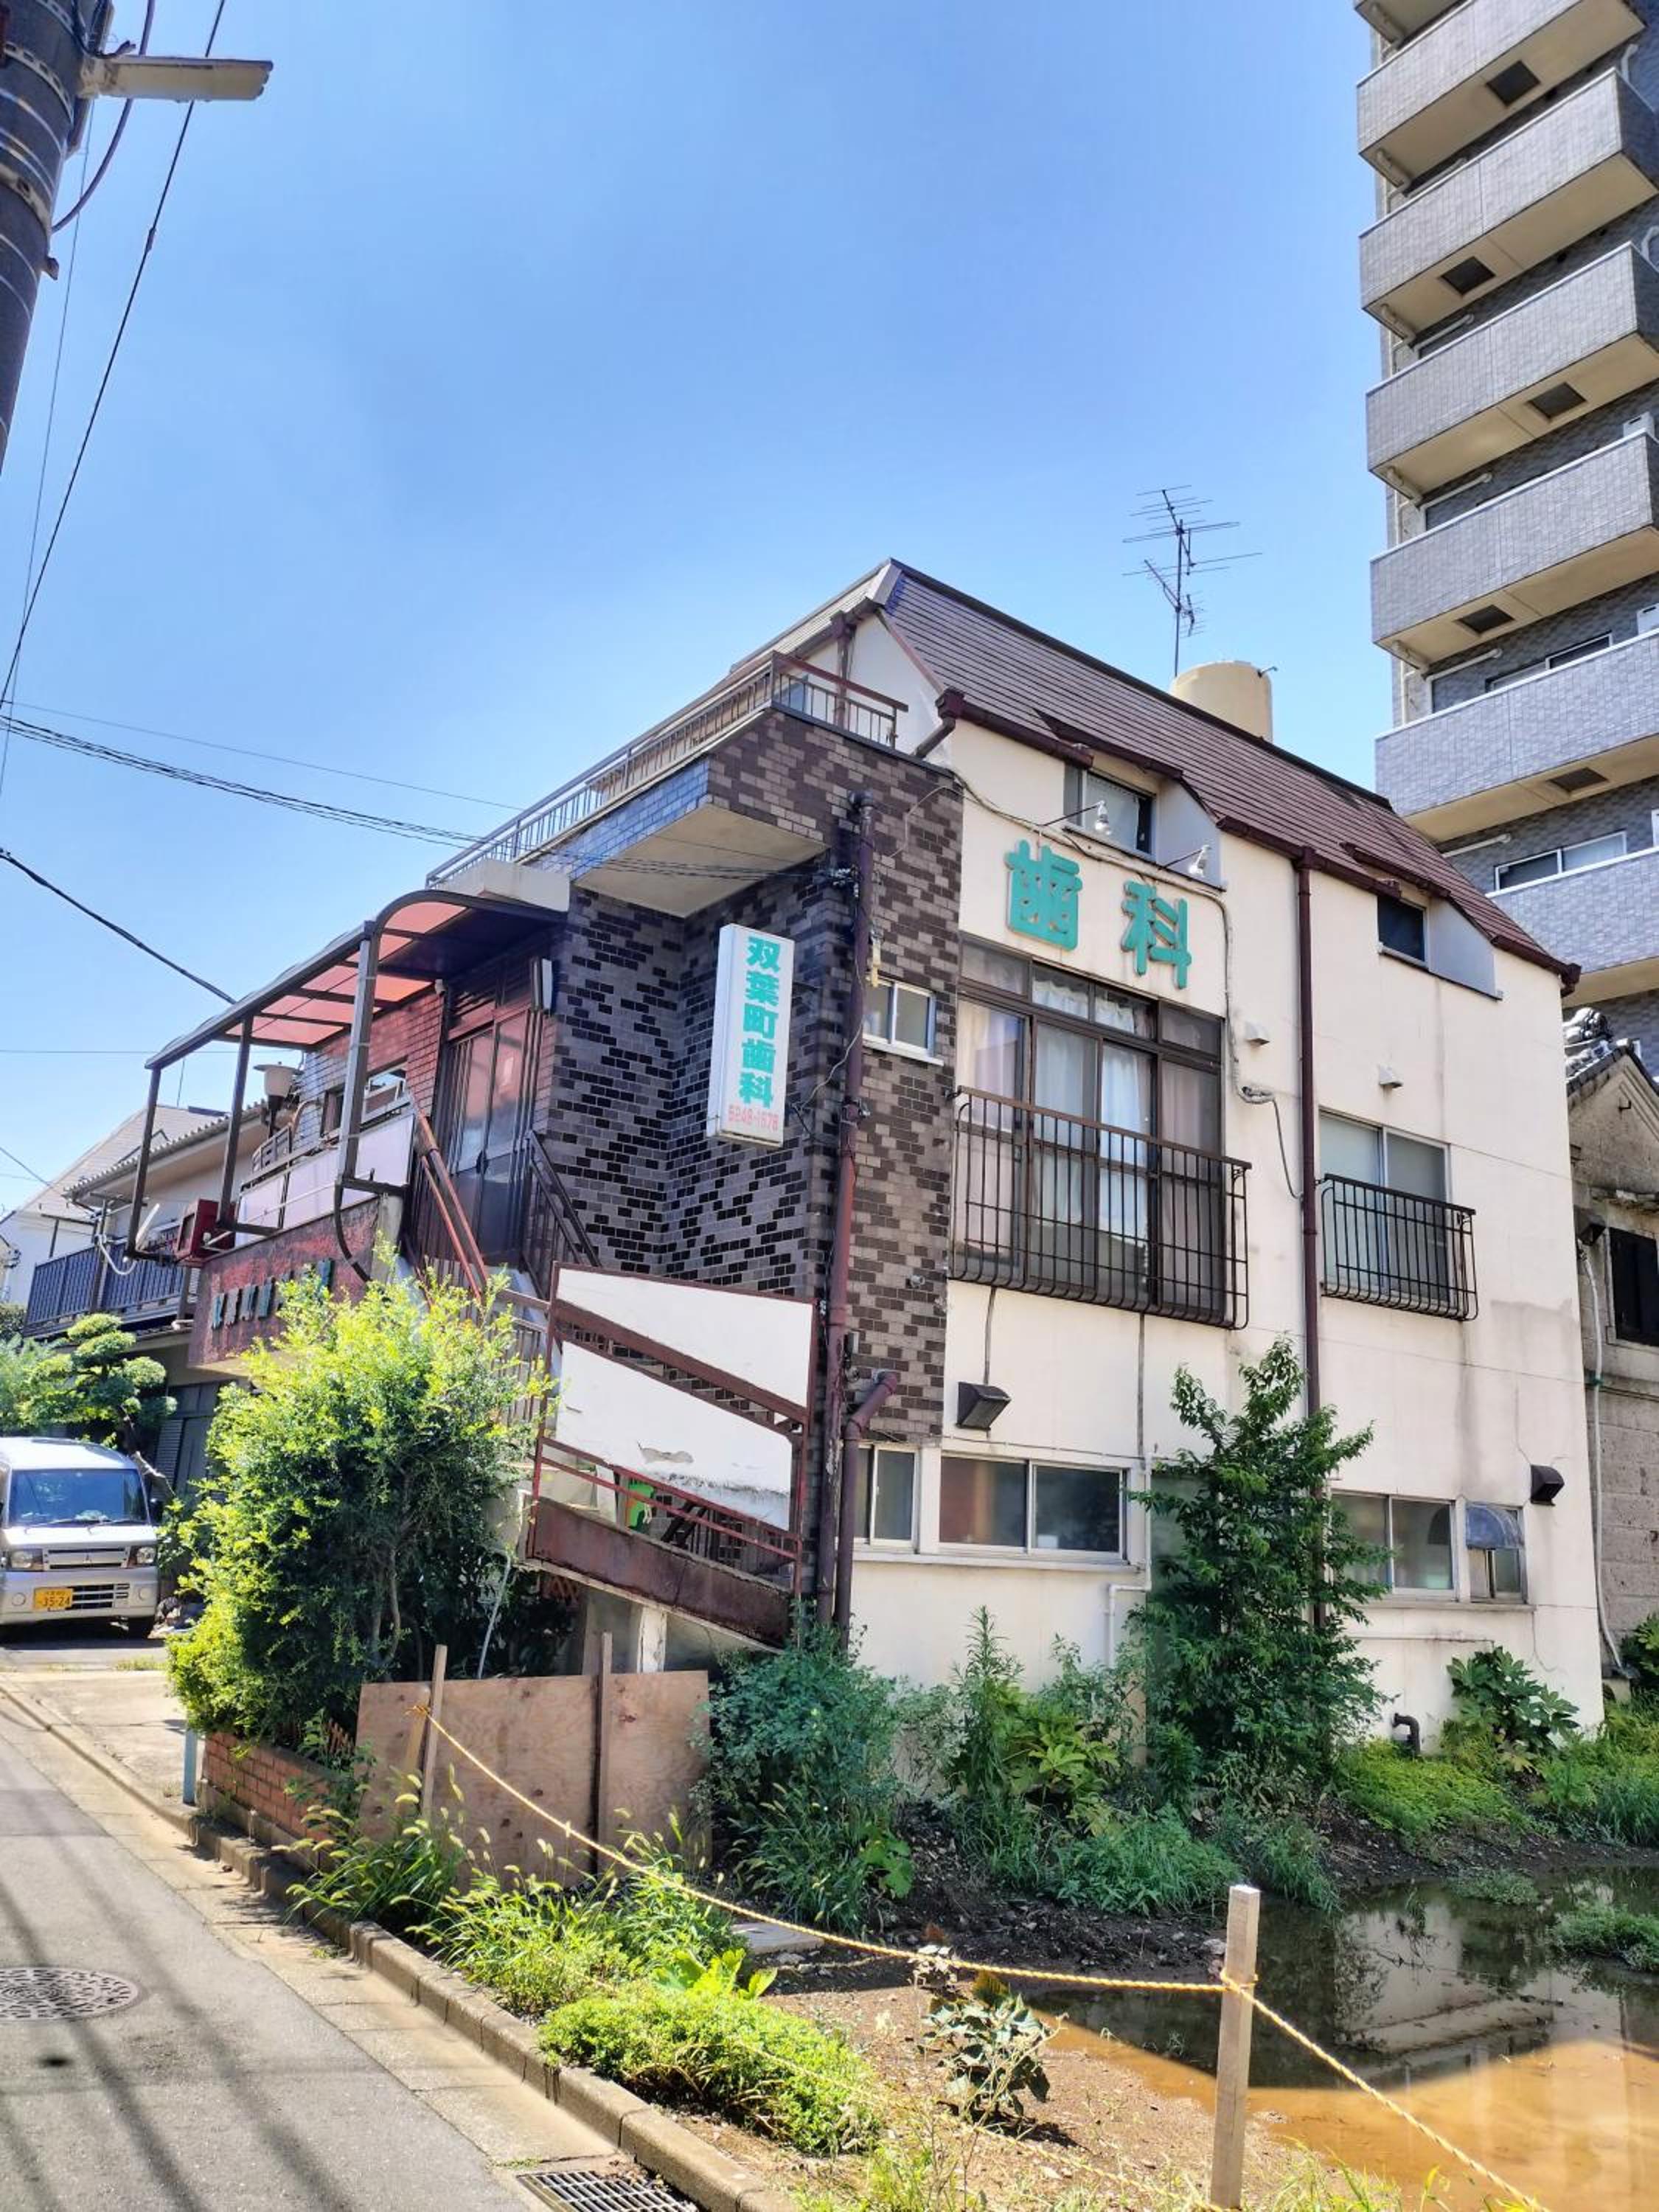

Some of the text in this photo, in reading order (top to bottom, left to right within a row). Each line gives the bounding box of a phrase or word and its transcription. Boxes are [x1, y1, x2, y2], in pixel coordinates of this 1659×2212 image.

[1004, 839, 1192, 990] 歯科
[738, 936, 780, 1109] 双葉町歯科
